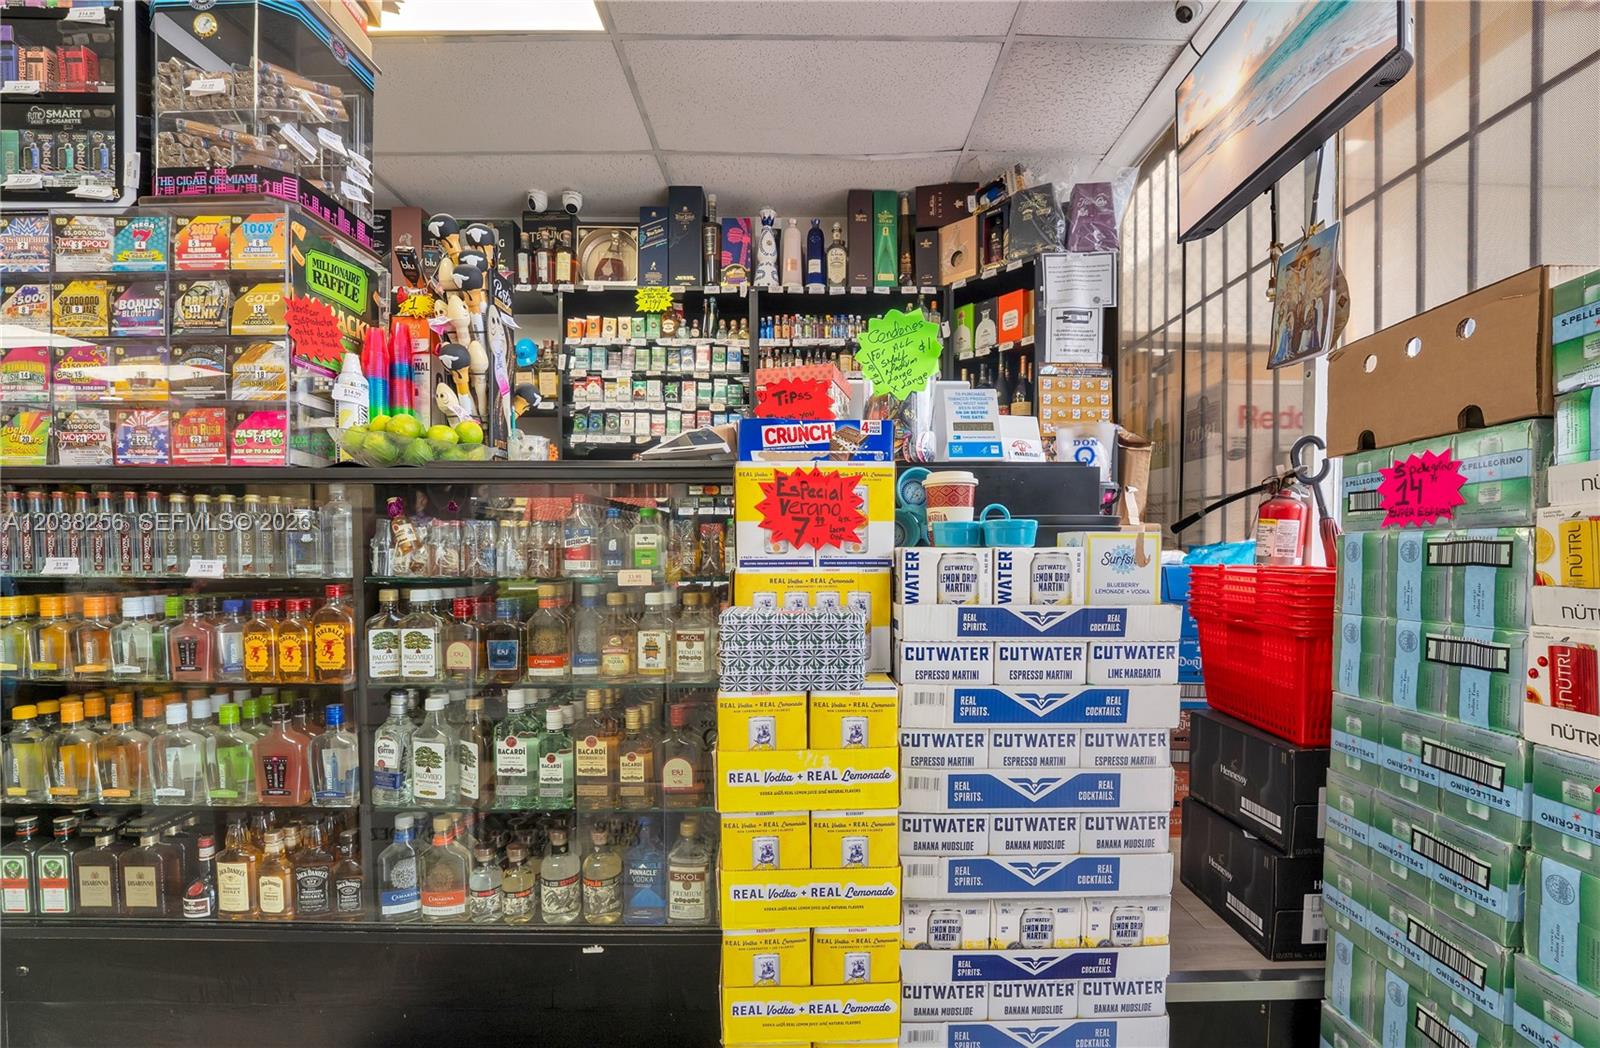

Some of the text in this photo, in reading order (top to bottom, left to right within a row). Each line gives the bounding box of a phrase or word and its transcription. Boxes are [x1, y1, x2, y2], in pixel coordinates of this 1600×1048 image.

[46, 109, 82, 119] SMART
[158, 176, 175, 186] THE
[177, 176, 207, 186] CIGAR
[226, 174, 258, 185] MIAMI
[243, 224, 273, 234] 100X
[401, 260, 415, 270] blu
[425, 257, 437, 267] blu
[312, 257, 361, 287] MILLIONAIRE
[312, 270, 360, 304] RAFFLE
[185, 296, 219, 306] BREAK
[245, 294, 280, 303] GOLD
[236, 430, 257, 438] FAST
[862, 422, 869, 434] 4
[764, 425, 834, 445] CRUNCH
[1462, 455, 1523, 471] S.PELLEGRINO
[1395, 479, 1423, 506] 14
[779, 499, 842, 517] Verano
[792, 517, 810, 545] 7
[940, 574, 977, 584] LEMON DROP
[1033, 574, 1070, 583] LEMON DROP
[945, 583, 972, 593] MARTINI
[1038, 583, 1065, 592] MARTINI
[963, 613, 977, 622] REAL
[1107, 614, 1121, 622] REAL
[963, 623, 988, 632] SPIRITS.
[1090, 623, 1121, 632] COCKTAILS.
[316, 627, 344, 641] FIREBALL
[905, 647, 989, 662] CUTWATER
[1000, 647, 1083, 662] CUTWATER
[1093, 645, 1176, 660] CUTWATER
[915, 670, 980, 680] ESPRESSO MARTINI
[1108, 668, 1161, 679] LIME MARGARITA
[961, 696, 977, 705] REAL
[1106, 696, 1121, 705] REAL
[960, 707, 990, 716] SPIRITS.
[1086, 707, 1122, 716] COCKTAILS.
[901, 733, 984, 748] CUTWATER
[993, 733, 1076, 748] CUTWATER
[1085, 733, 1166, 748] CUTWATER
[1551, 723, 1600, 747] NÜTR
[1004, 756, 1066, 767] ESPRESSO MARTINI
[729, 770, 891, 783] REAL Vodka REAL Lemonade
[1219, 765, 1248, 786] Hennessy
[1450, 780, 1511, 808] S.PELLEGRINO
[902, 818, 986, 833] CUTWATER
[994, 817, 1076, 832] CUTWATER
[1085, 816, 1166, 831] CUTWATER
[913, 841, 974, 851] BANANA MUDSLIDE
[1208, 856, 1234, 881] Hennessy
[734, 887, 894, 899] REAL Vodka REAL Lemonade
[1439, 872, 1497, 907] S.PELLEGRINO
[994, 984, 1075, 998] CUTWATER
